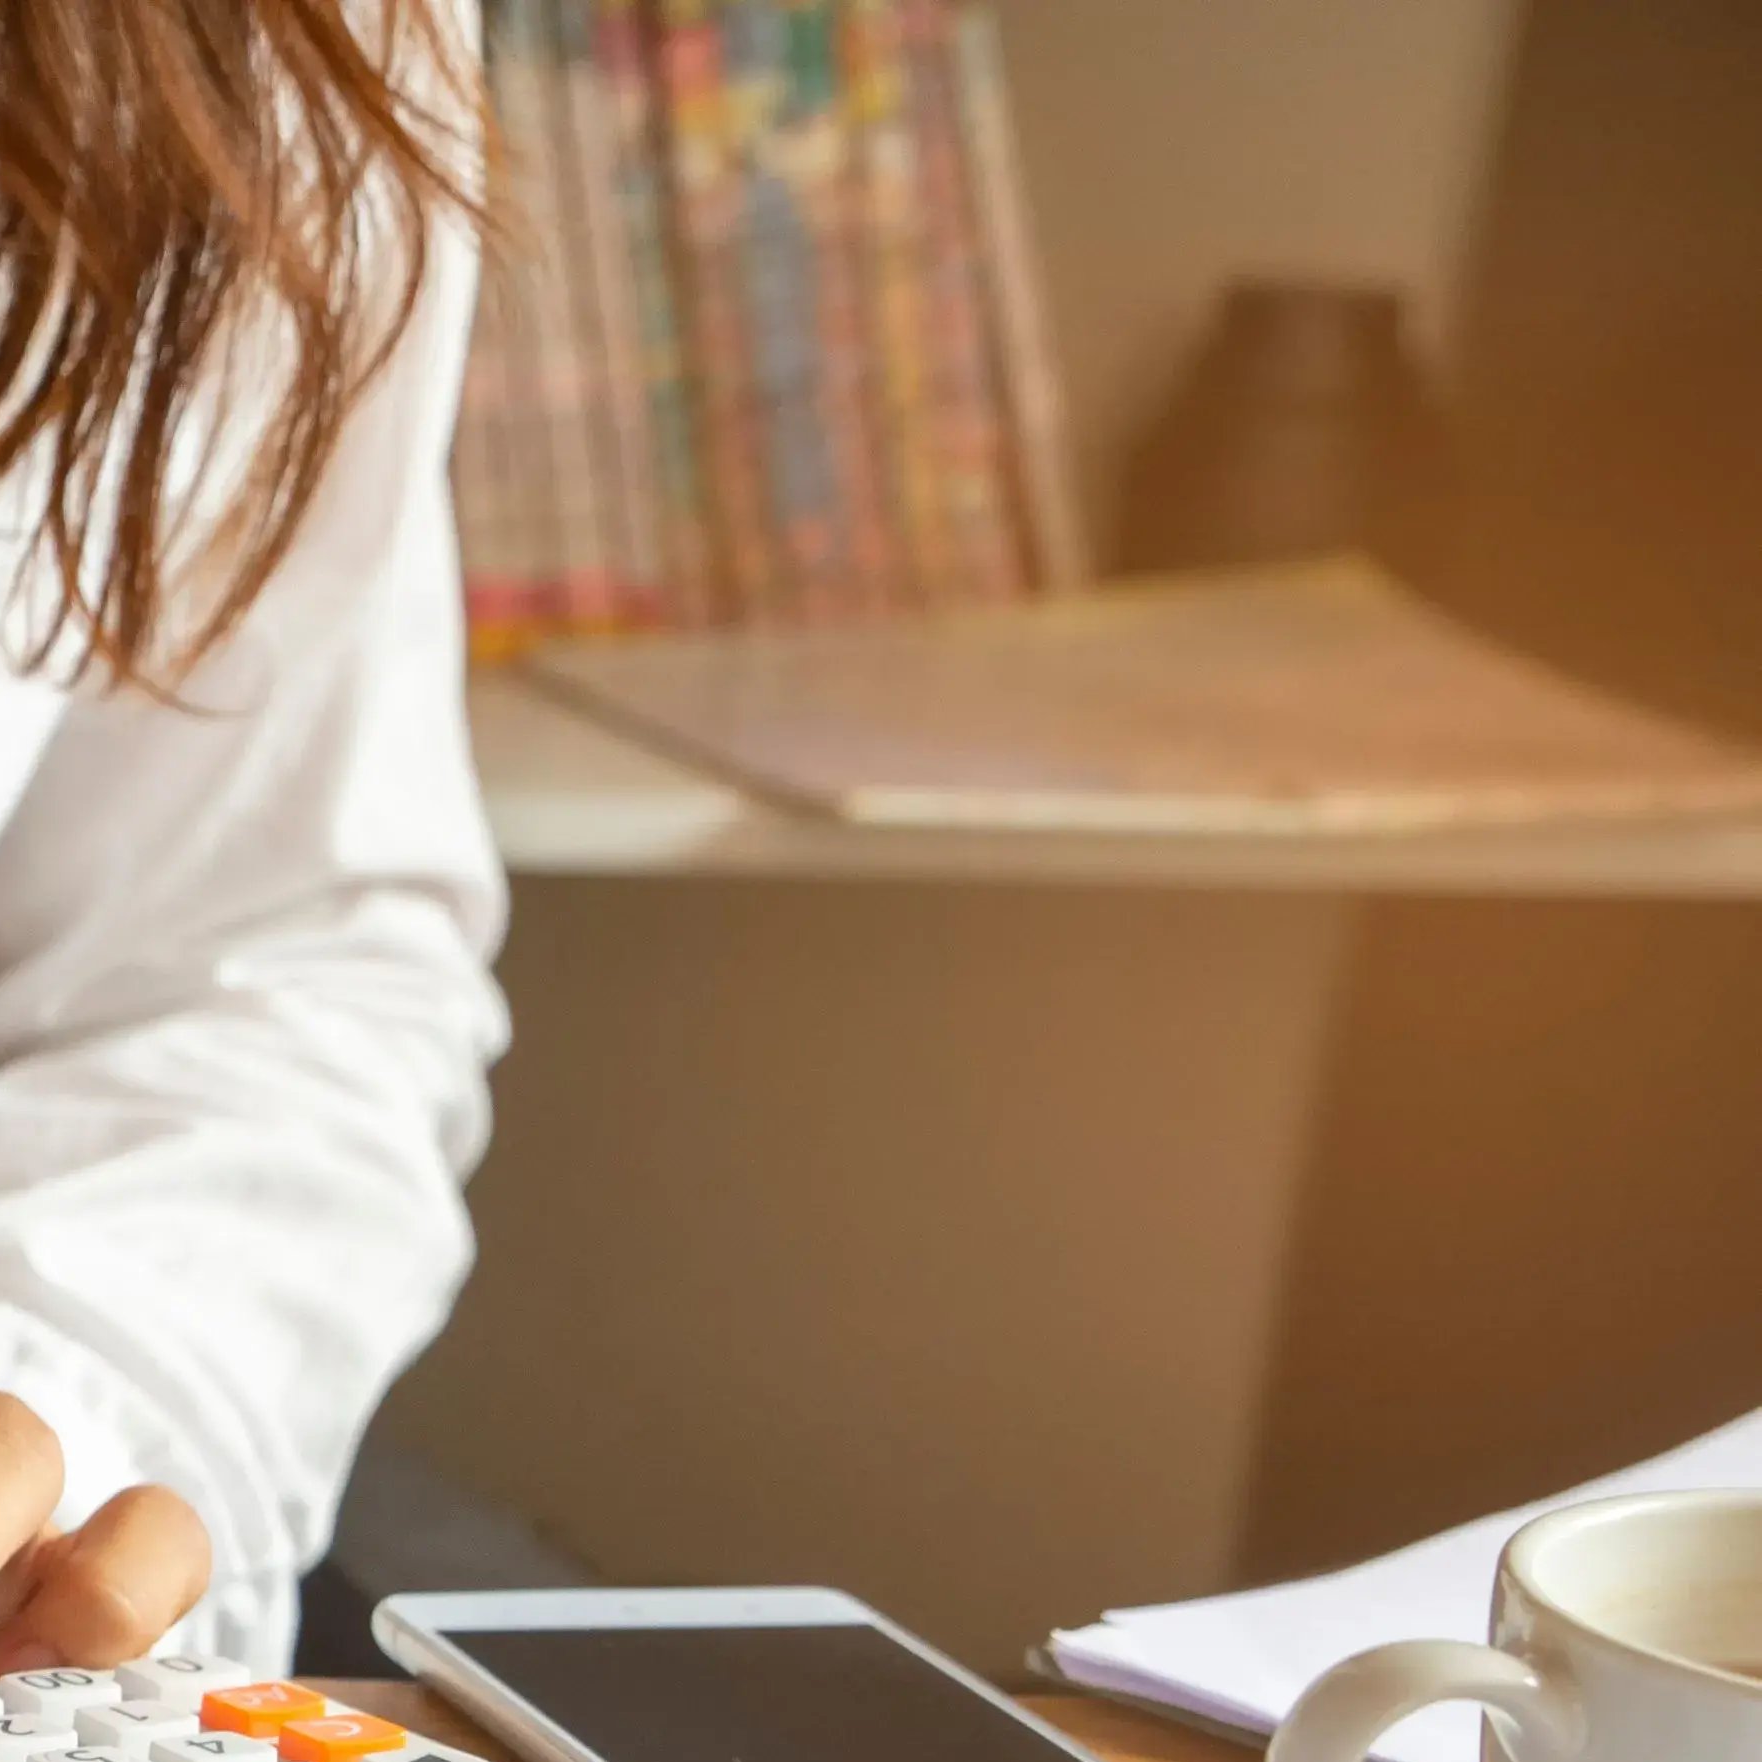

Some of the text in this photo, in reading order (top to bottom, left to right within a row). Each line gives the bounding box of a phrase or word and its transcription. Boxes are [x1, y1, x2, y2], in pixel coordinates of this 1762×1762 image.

[157, 1656, 203, 1674] 0
[17, 1669, 94, 1690] 00
[220, 1683, 288, 1706] AC
[113, 1706, 150, 1722] 1
[328, 1719, 363, 1738] C
[186, 1739, 226, 1755] 4
